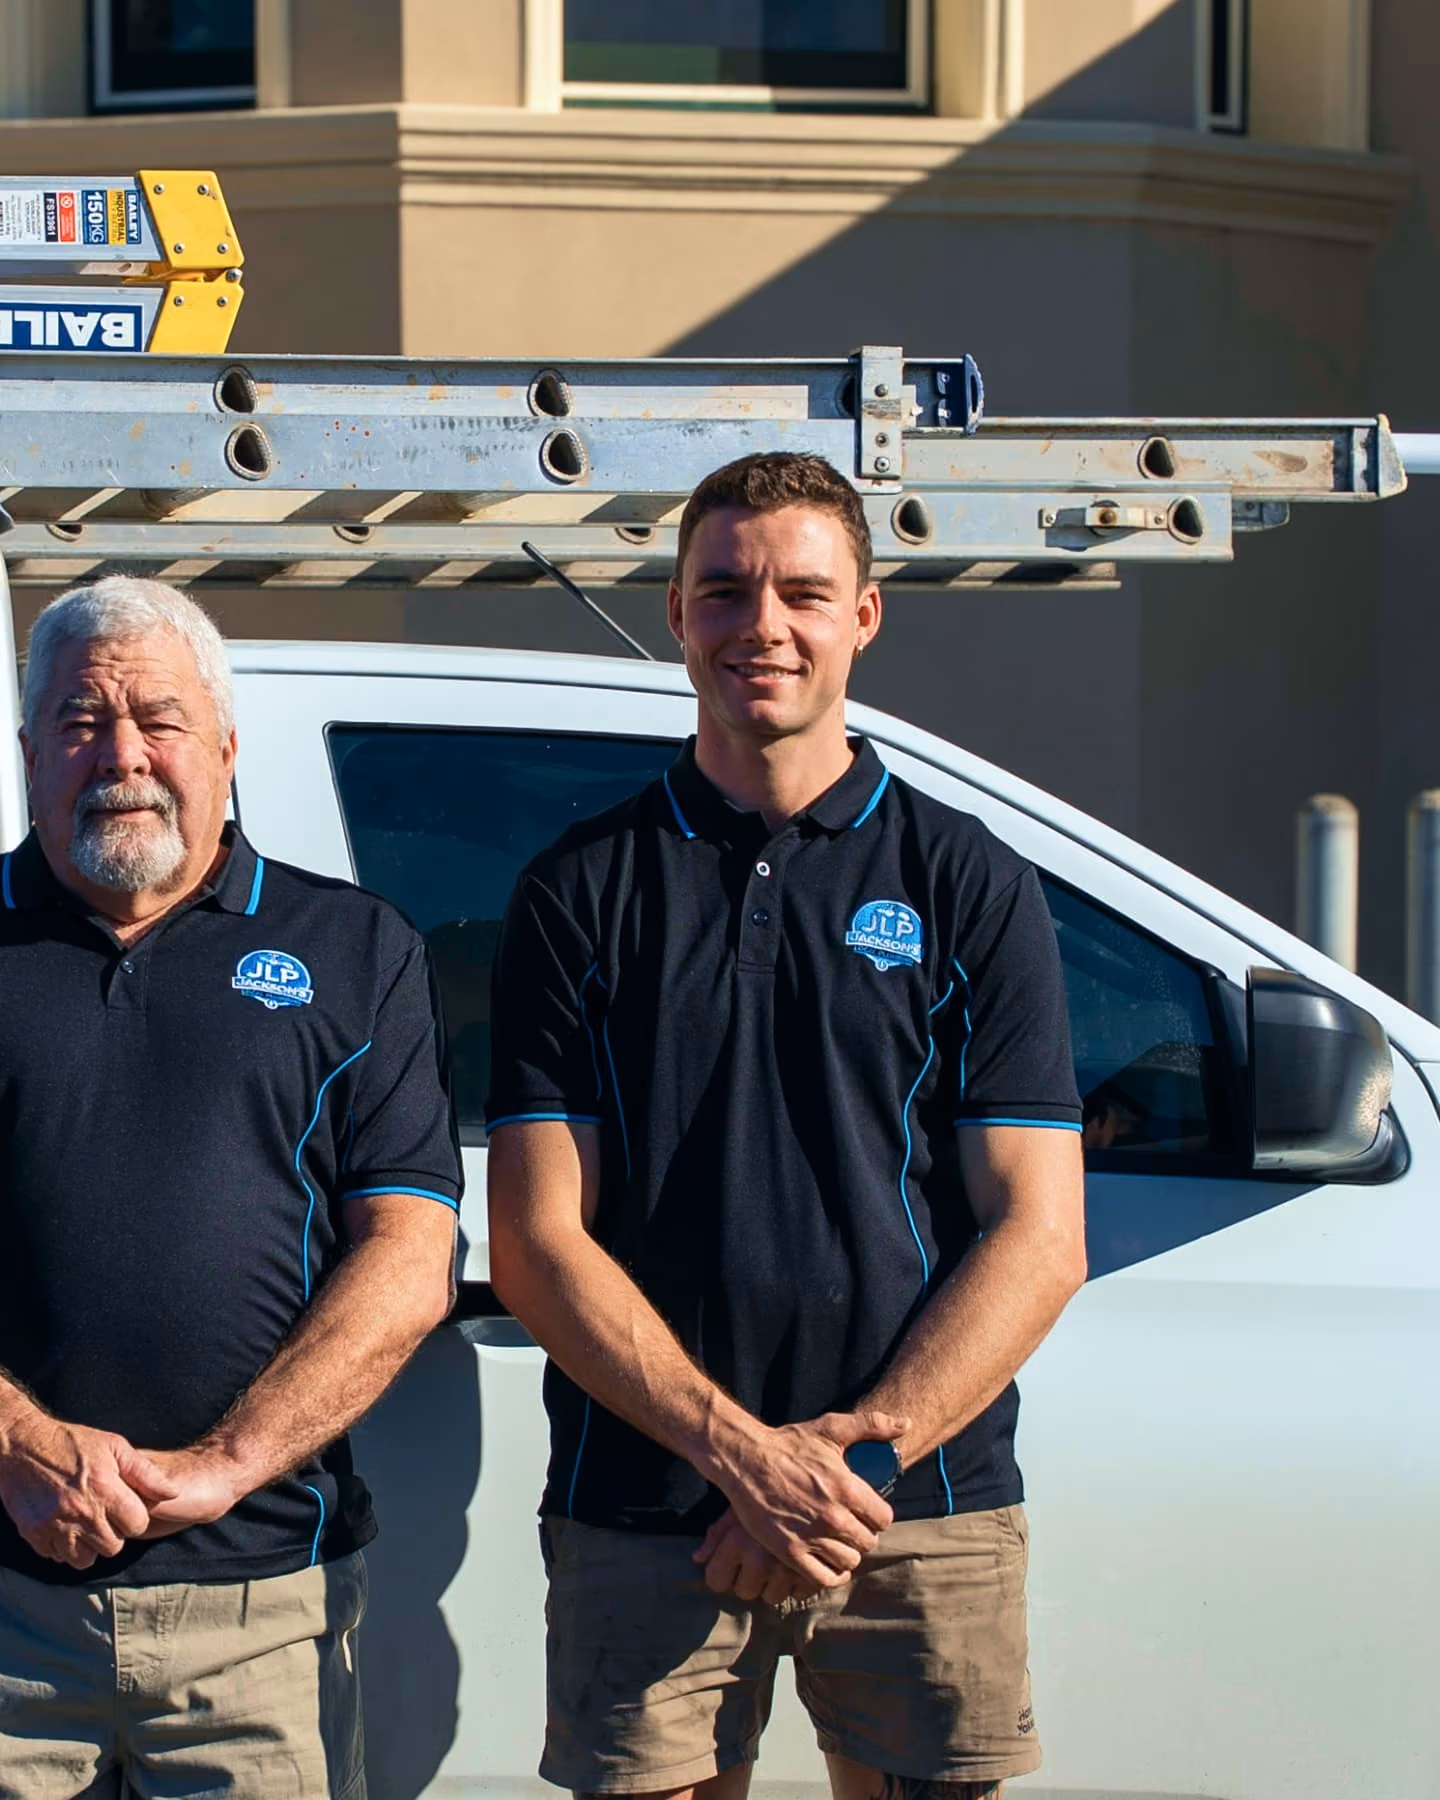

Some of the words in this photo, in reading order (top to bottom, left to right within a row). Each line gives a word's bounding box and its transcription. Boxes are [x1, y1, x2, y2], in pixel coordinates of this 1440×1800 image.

[117, 192, 125, 241] INDUSTRIAL
[128, 194, 138, 239] BAILEY
[861, 915, 913, 938] JLP
[849, 931, 921, 955] JACKSON'S
[246, 962, 299, 983] JLP
